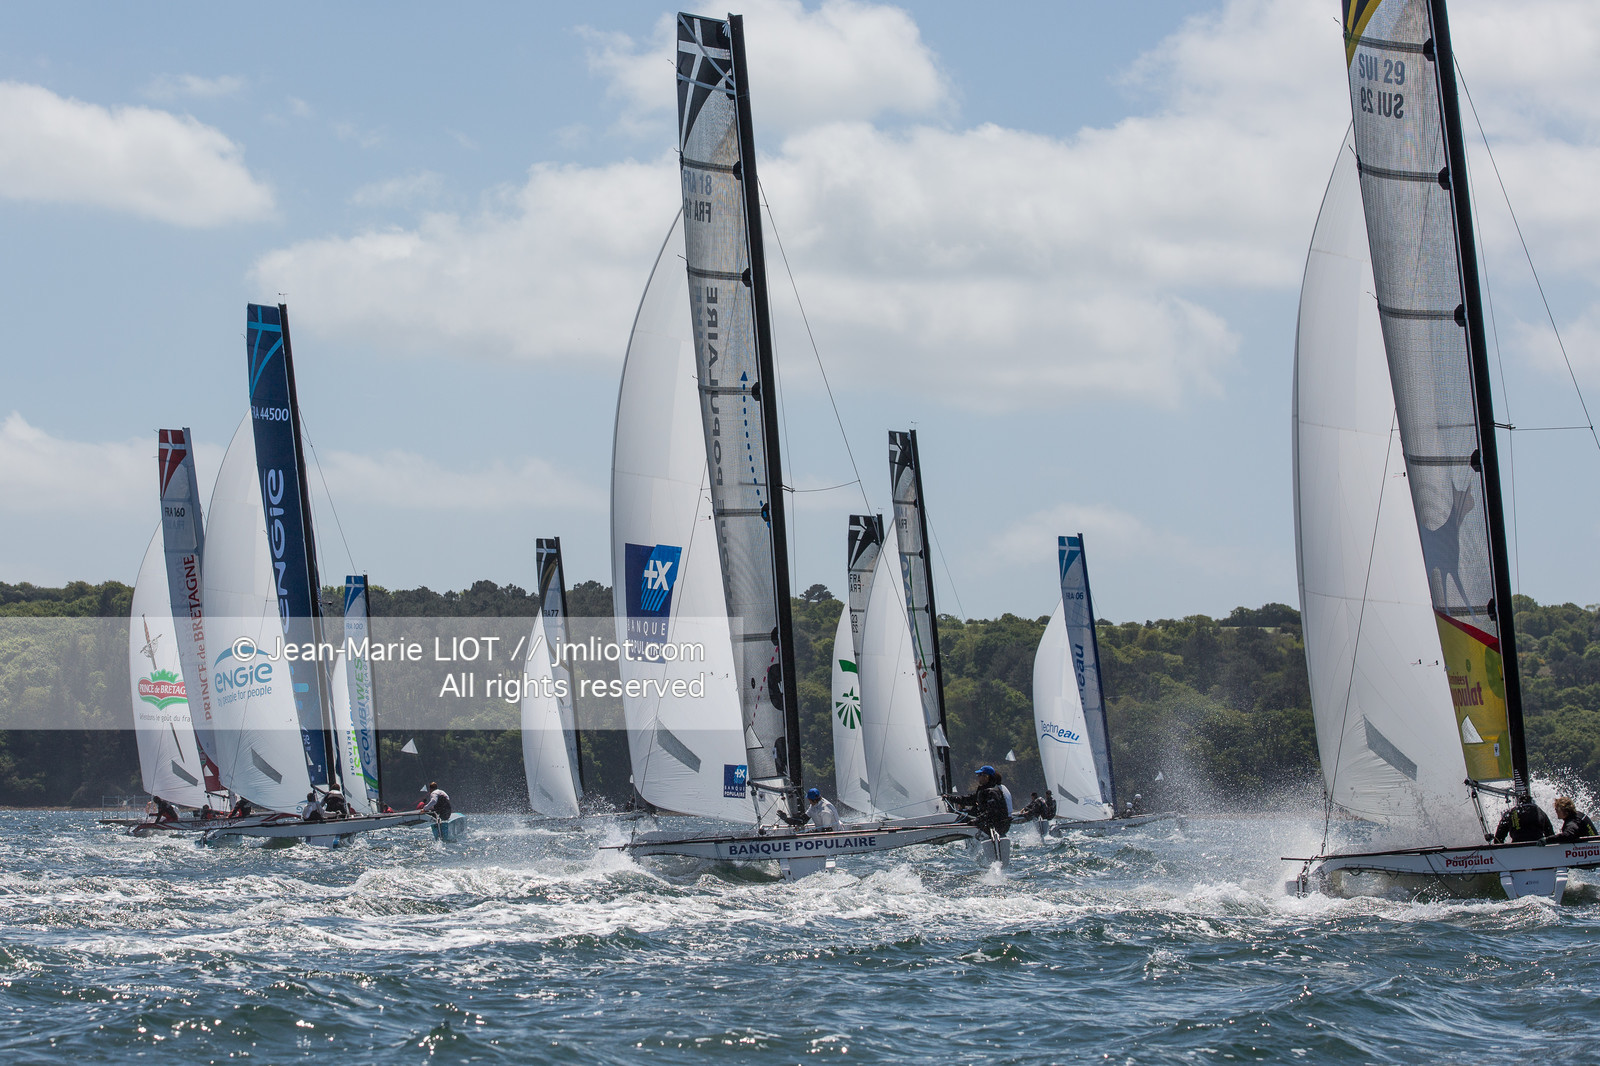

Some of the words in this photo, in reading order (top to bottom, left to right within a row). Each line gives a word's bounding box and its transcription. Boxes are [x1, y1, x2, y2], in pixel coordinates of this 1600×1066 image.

[1358, 53, 1379, 81] SUI
[1383, 58, 1405, 86] 29
[699, 173, 712, 196] 18
[260, 407, 289, 421] 44500
[174, 507, 186, 518] 160
[850, 573, 861, 584] FRA
[183, 554, 204, 643] BRETAGNE
[247, 685, 272, 700] people
[1041, 720, 1079, 741] Techneau
[729, 842, 790, 855] BANQUE
[795, 836, 876, 851] POPULAIRE
[1445, 855, 1494, 868] Poujoulat
[1565, 849, 1600, 859] Poujou
